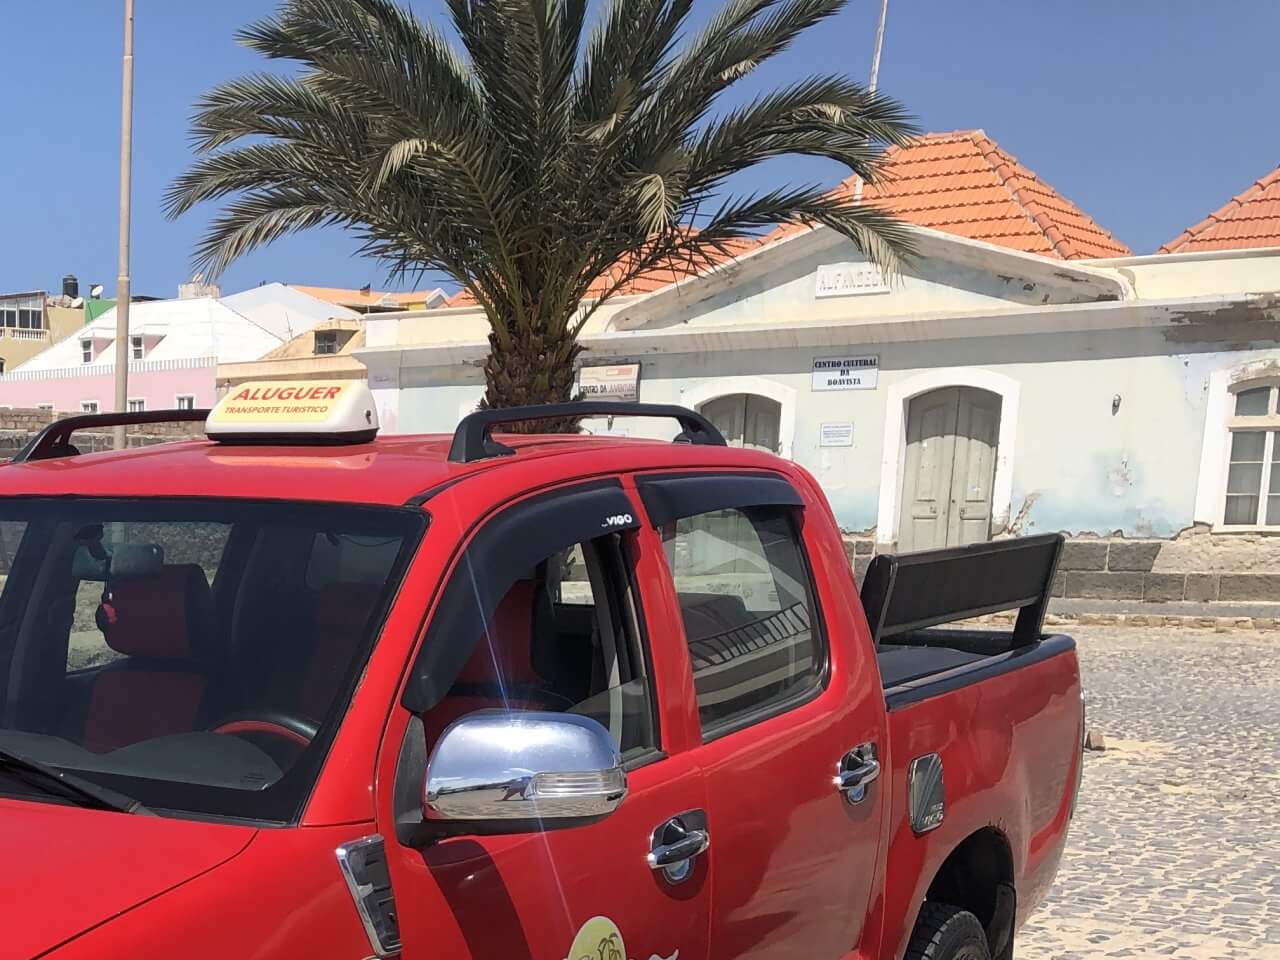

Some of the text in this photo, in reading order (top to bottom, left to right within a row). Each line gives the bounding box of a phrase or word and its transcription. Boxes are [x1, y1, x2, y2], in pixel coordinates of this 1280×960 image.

[814, 358, 877, 368] CENTRO CULTURAL
[840, 369, 850, 377] DA
[827, 378, 861, 386] BOAVISTA
[232, 386, 342, 401] ALUGUER
[224, 406, 281, 414] TRANSPORTE
